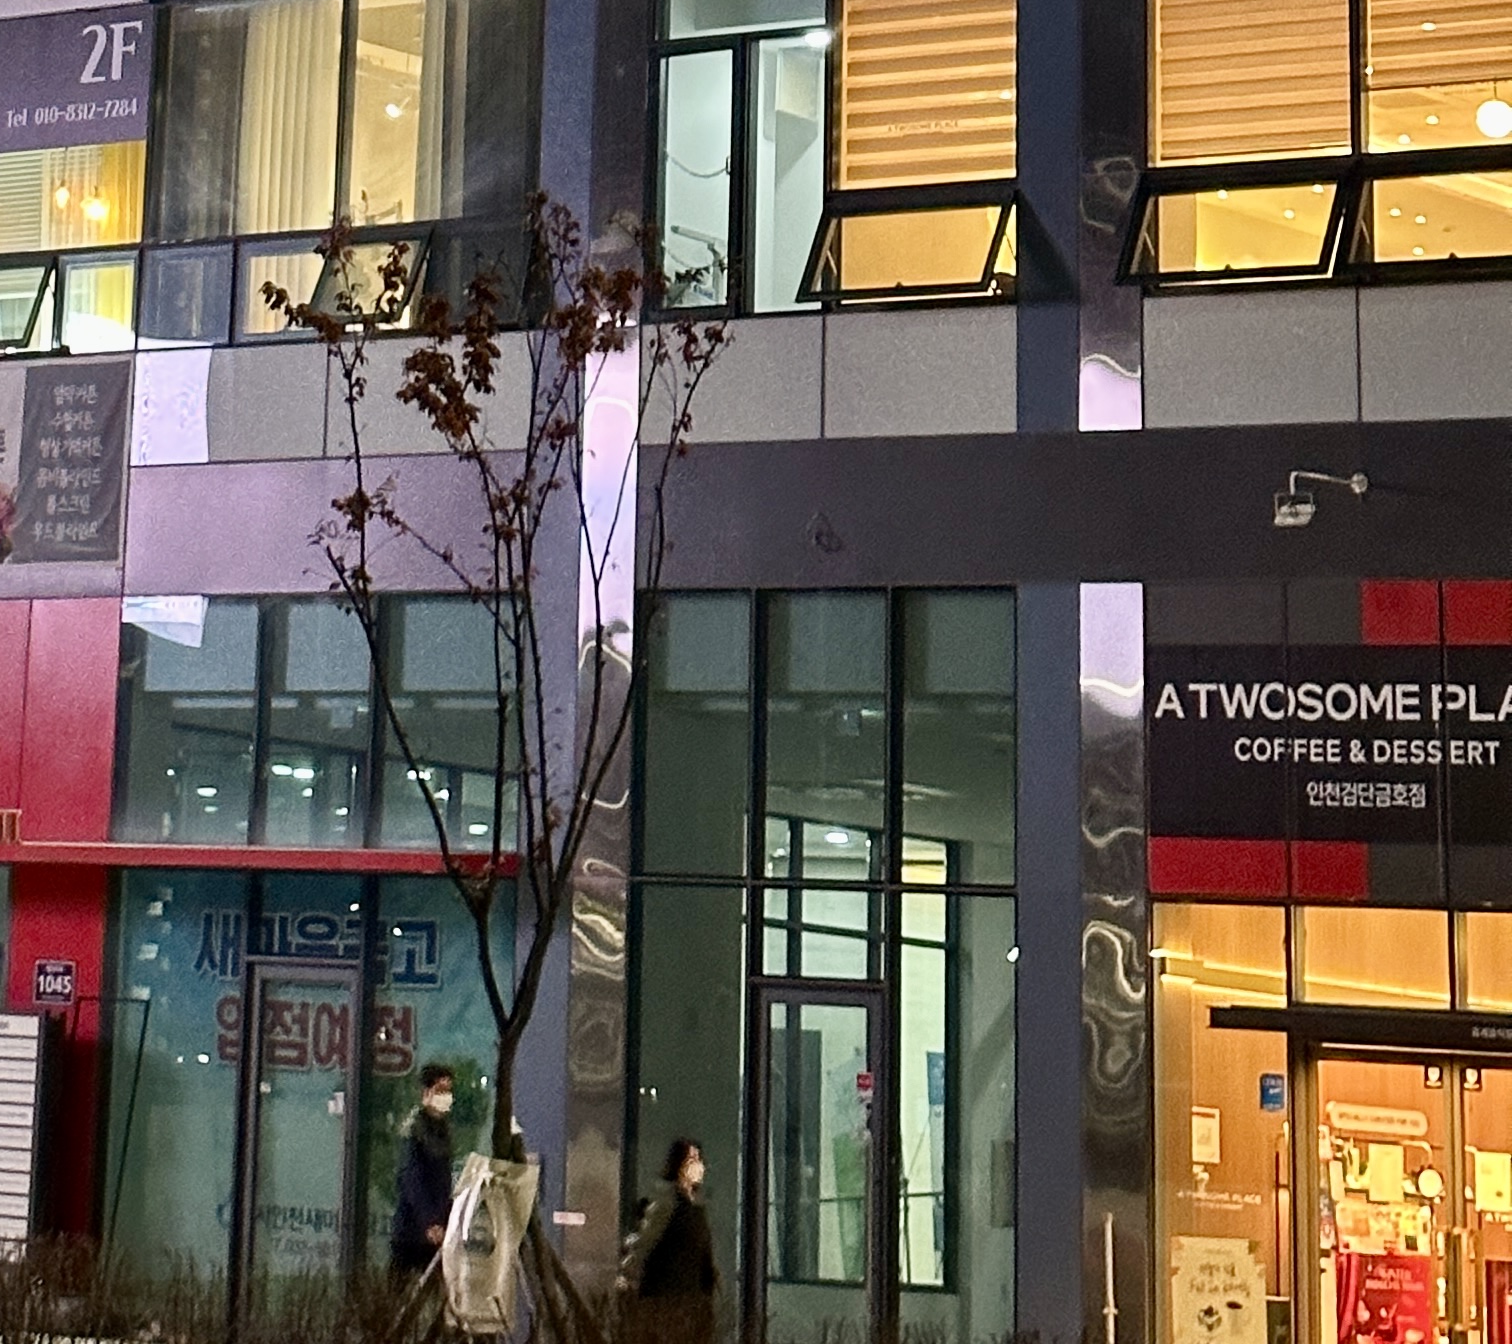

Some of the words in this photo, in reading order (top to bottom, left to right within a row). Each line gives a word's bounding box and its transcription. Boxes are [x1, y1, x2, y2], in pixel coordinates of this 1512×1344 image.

[79, 20, 144, 85] 2F
[1154, 683, 1186, 720] A
[1187, 681, 1421, 722] TWOSOME
[1234, 736, 1342, 763] COFFEE
[1349, 737, 1366, 763] &
[1373, 739, 1500, 766] DESSERT
[1306, 780, 1427, 808] 인천검단금호점
[38, 974, 72, 994] 1045
